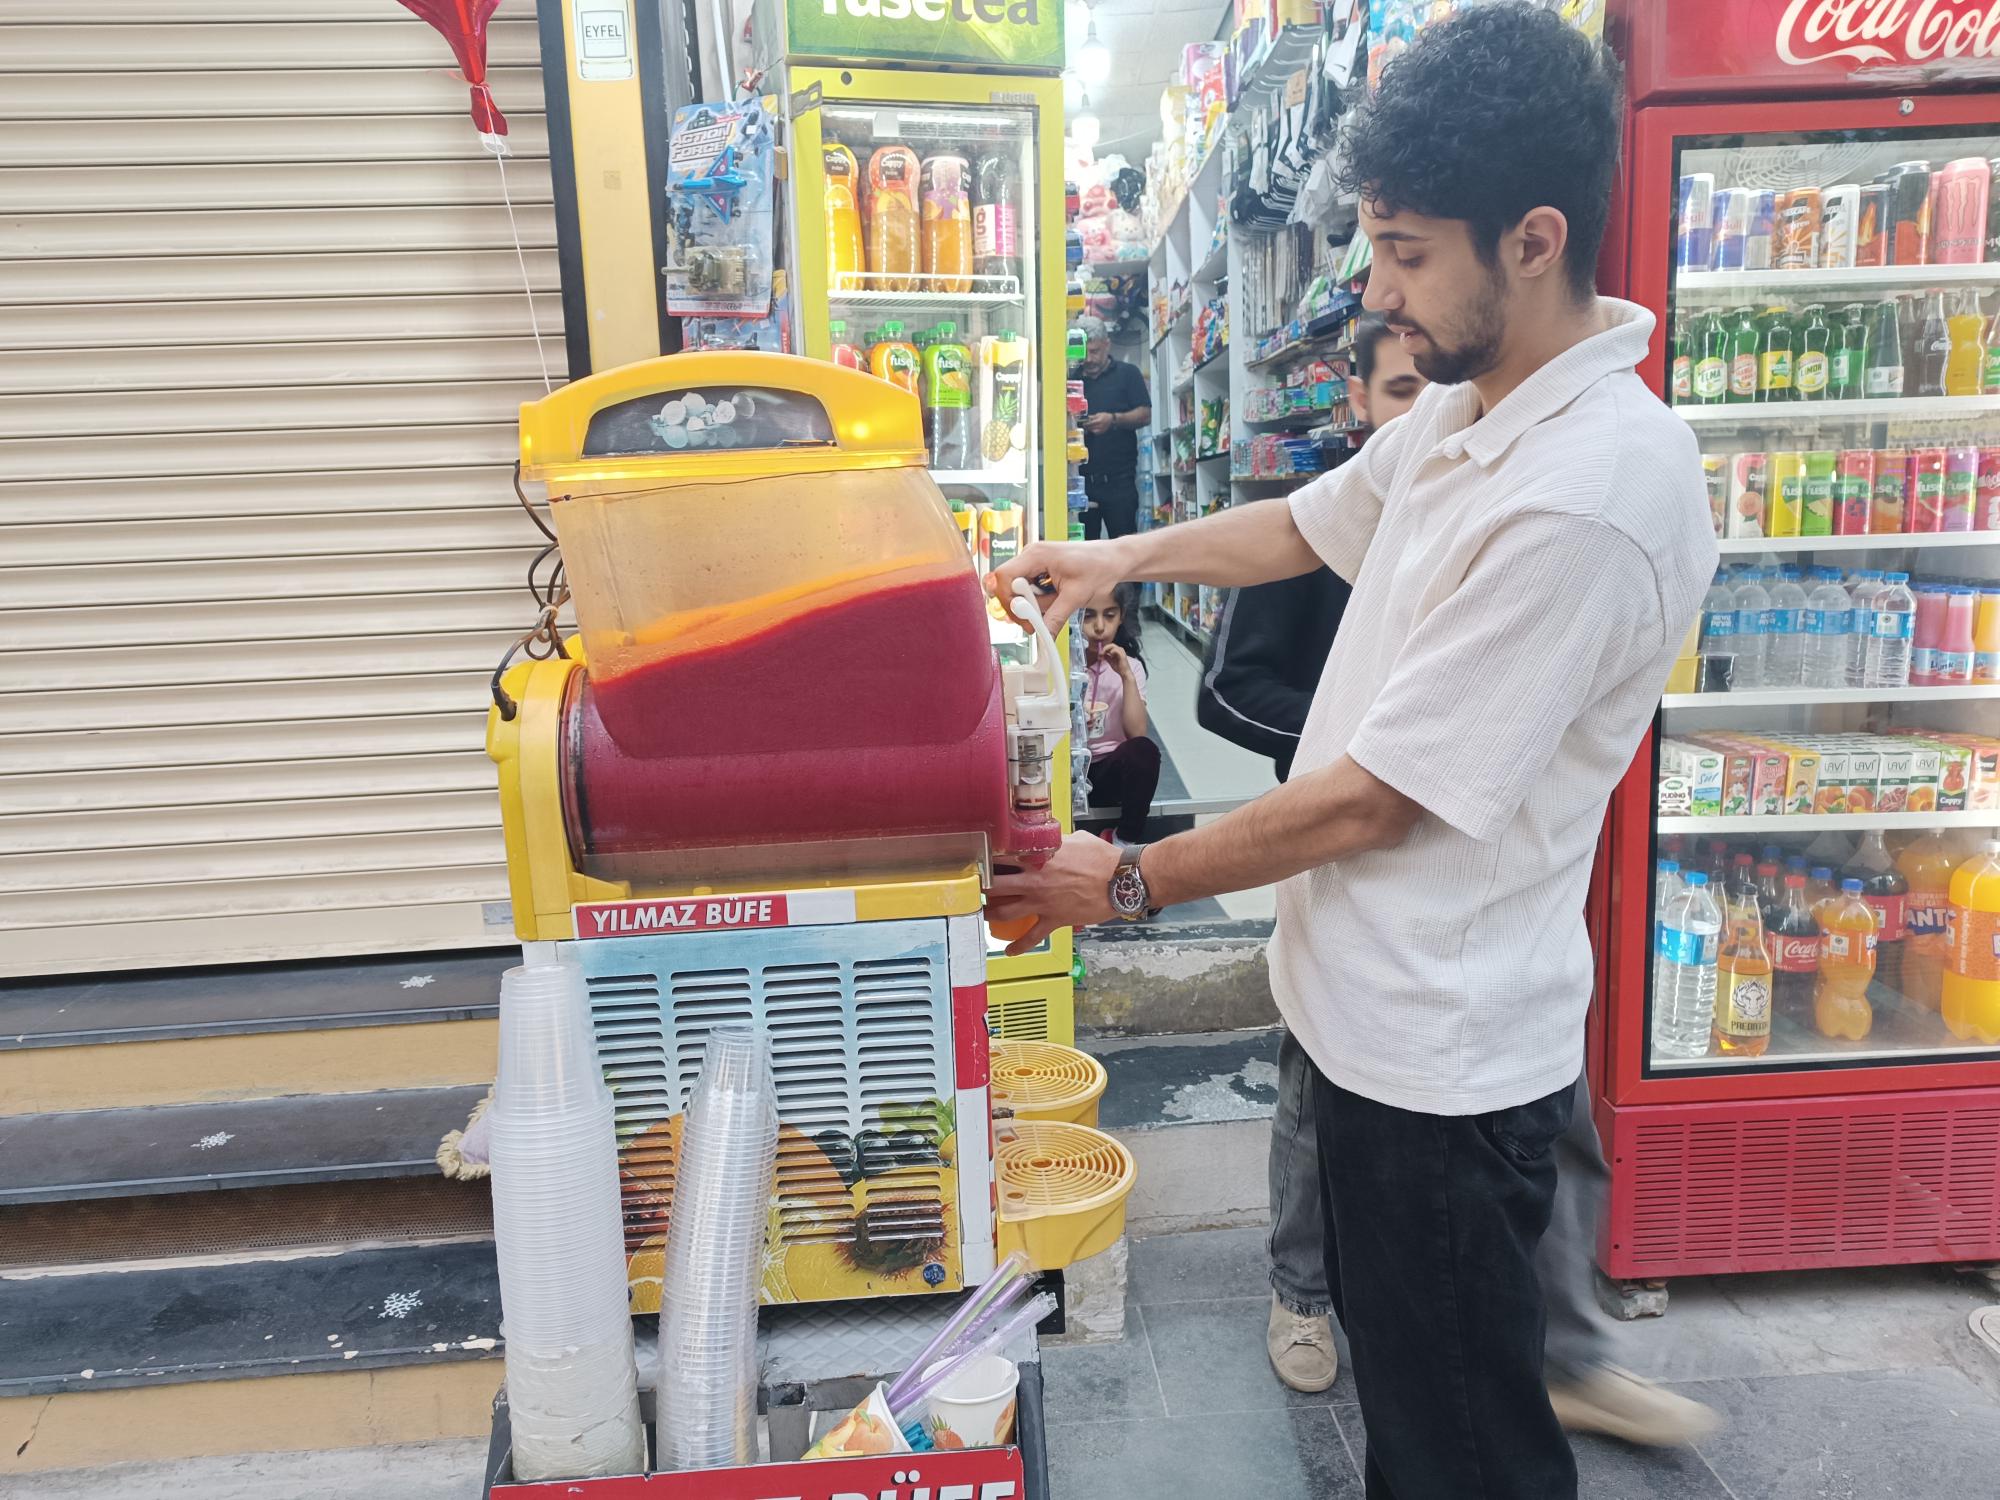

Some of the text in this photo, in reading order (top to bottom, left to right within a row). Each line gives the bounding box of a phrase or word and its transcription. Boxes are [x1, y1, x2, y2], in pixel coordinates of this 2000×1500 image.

[585, 25, 622, 38] EYFEL
[672, 121, 733, 147] ACTION
[672, 141, 725, 159] FORCE
[1940, 796, 1962, 805] Cappy
[592, 897, 772, 932] YILMAZ BÜFE
